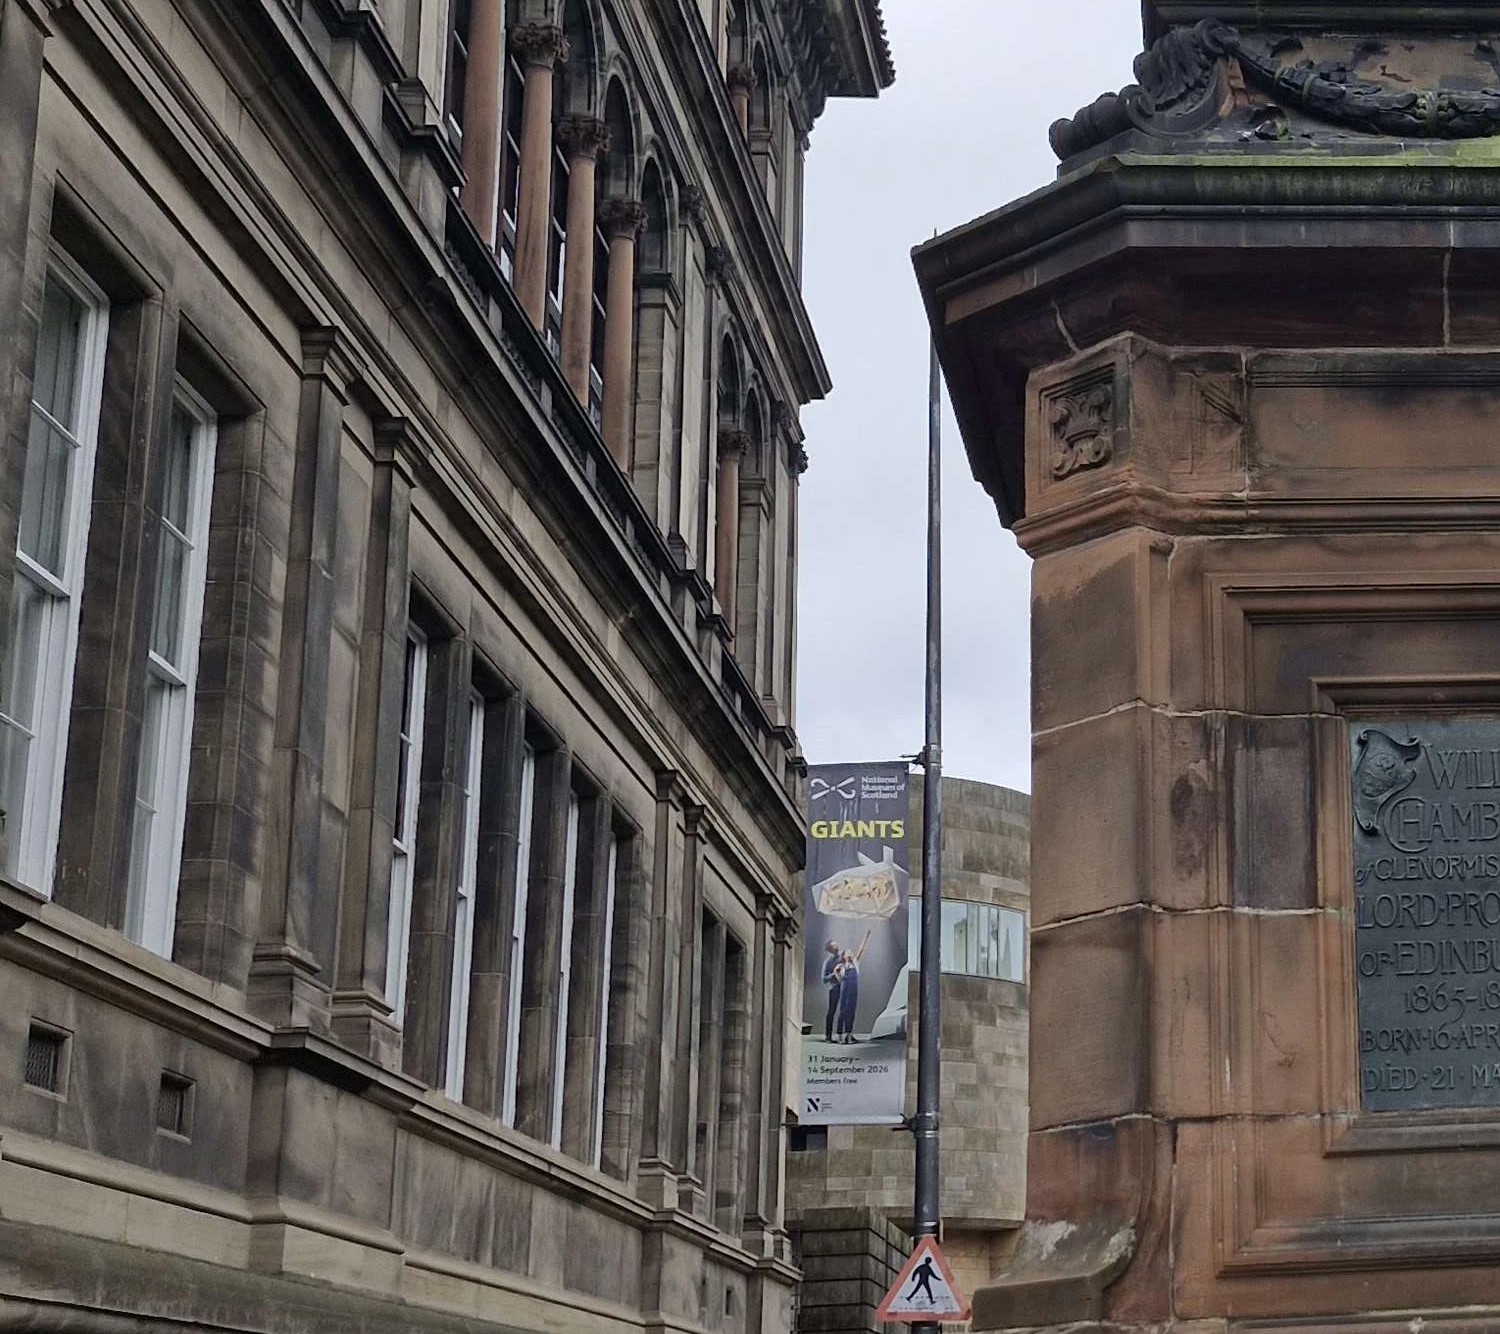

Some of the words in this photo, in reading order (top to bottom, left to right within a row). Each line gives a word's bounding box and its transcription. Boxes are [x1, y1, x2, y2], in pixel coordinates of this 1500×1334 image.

[861, 775, 899, 784] National
[896, 782, 905, 791] of
[861, 791, 898, 799] Scotland
[810, 819, 905, 839] GIANTS
[1356, 893, 1439, 929] LORD
[1359, 951, 1394, 977] OF
[1361, 1027, 1421, 1056] BORN
[1428, 1023, 1450, 1051] 16
[820, 1066, 865, 1075] September
[867, 1065, 889, 1074] 2026
[1364, 1059, 1418, 1092] DIED
[1431, 1066, 1455, 1090] 21
